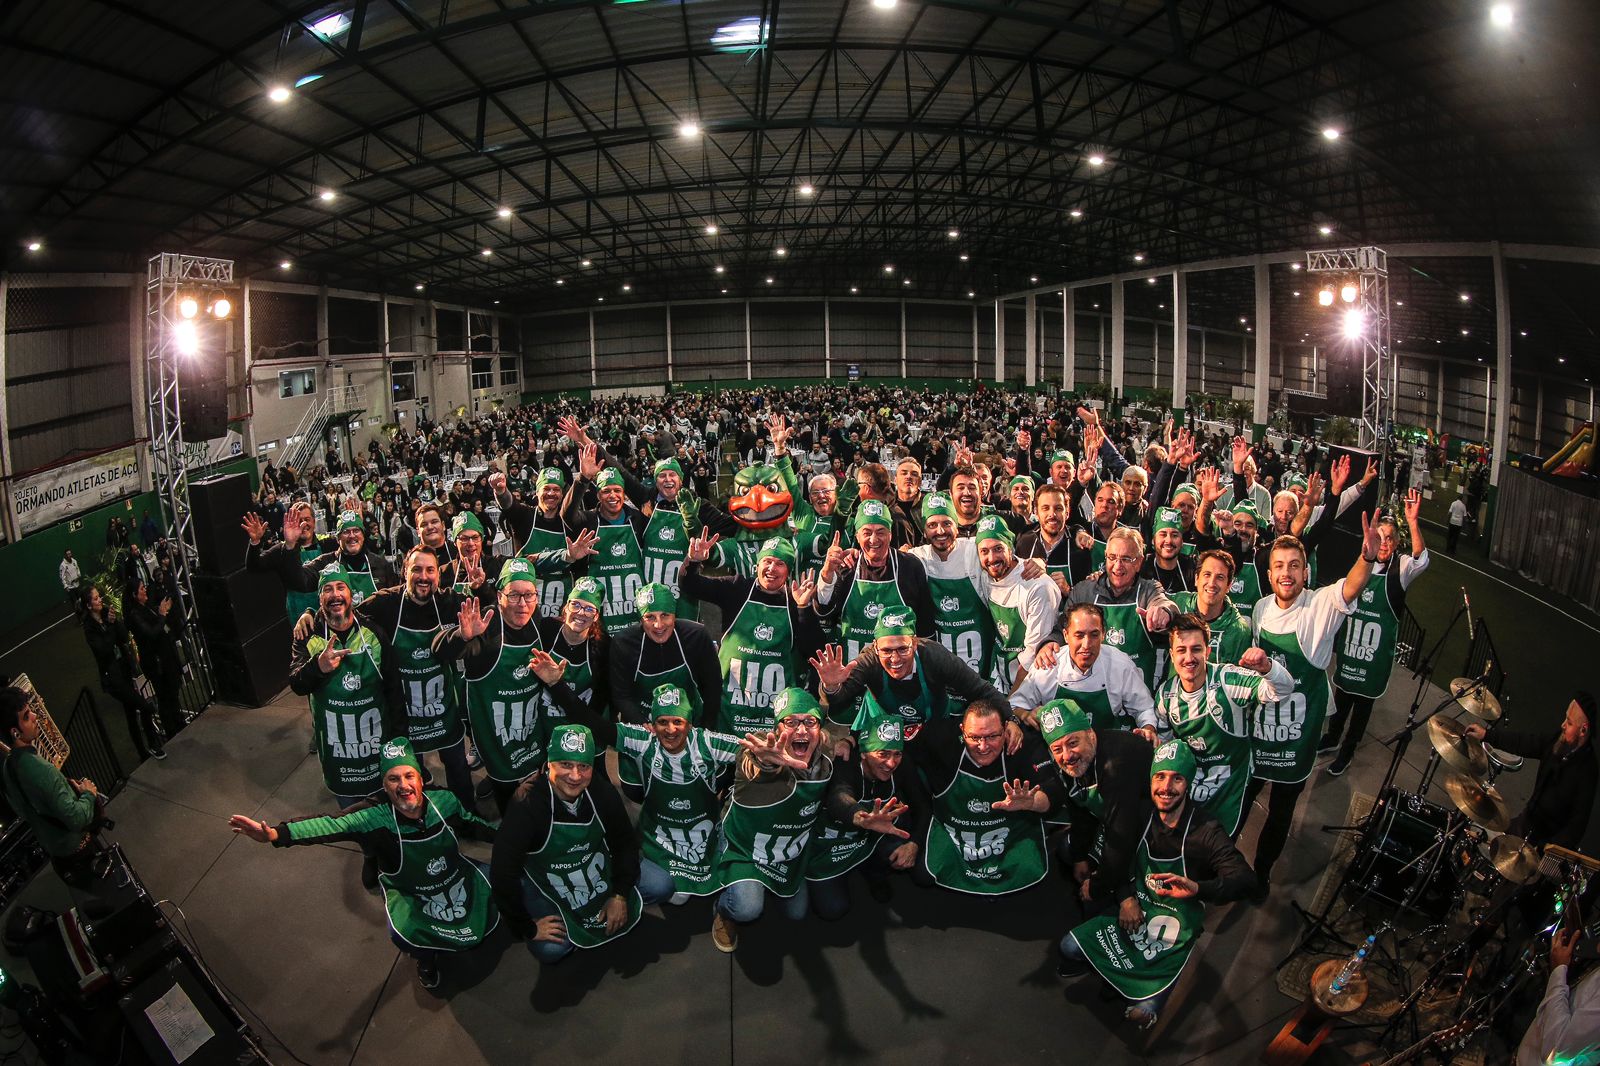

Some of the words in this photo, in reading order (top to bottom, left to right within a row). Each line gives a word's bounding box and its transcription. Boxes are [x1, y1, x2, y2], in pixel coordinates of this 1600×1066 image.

[14, 486, 38, 501] ROJETO
[16, 486, 65, 514] ORMANDO
[67, 472, 106, 497] ATLETAS
[108, 468, 120, 482] DE
[122, 462, 139, 479] AÇO
[738, 646, 753, 654] PAPOS
[728, 658, 786, 695] 110
[325, 708, 382, 746] 110
[1253, 722, 1302, 742] ANOS
[333, 737, 381, 758] ANOS
[952, 816, 970, 826] PAPOS
[1110, 932, 1124, 954] Sicredi
